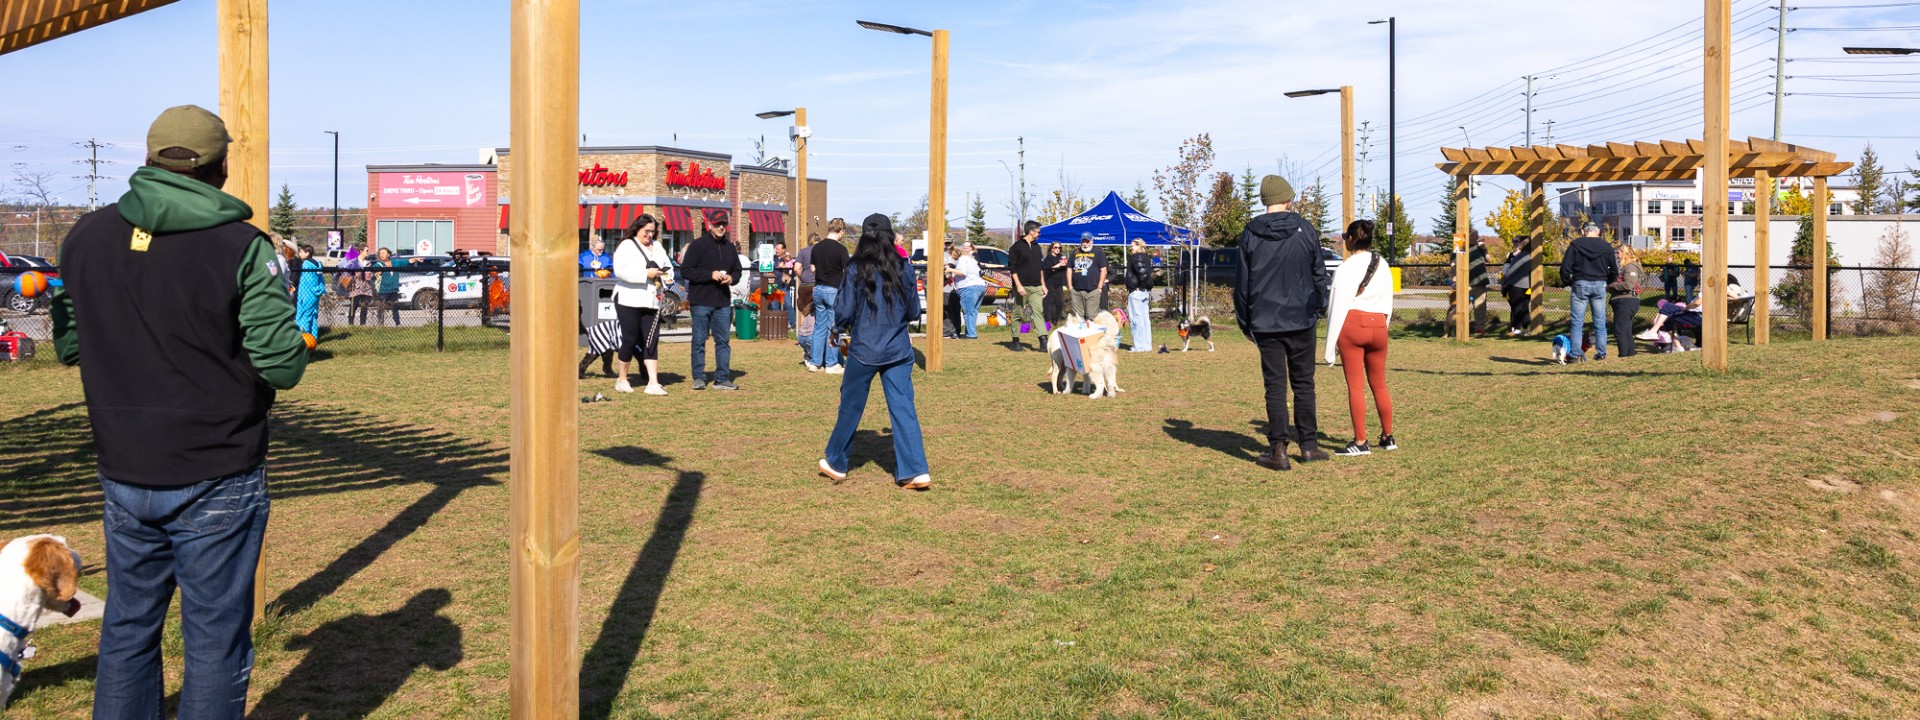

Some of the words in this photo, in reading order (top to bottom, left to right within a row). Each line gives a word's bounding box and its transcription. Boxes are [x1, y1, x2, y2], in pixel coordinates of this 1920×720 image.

[403, 175, 415, 184] Tim
[415, 175, 440, 184] Hortons
[578, 163, 628, 186] rtons
[665, 161, 686, 186] Tim
[685, 162, 726, 189] Hortons
